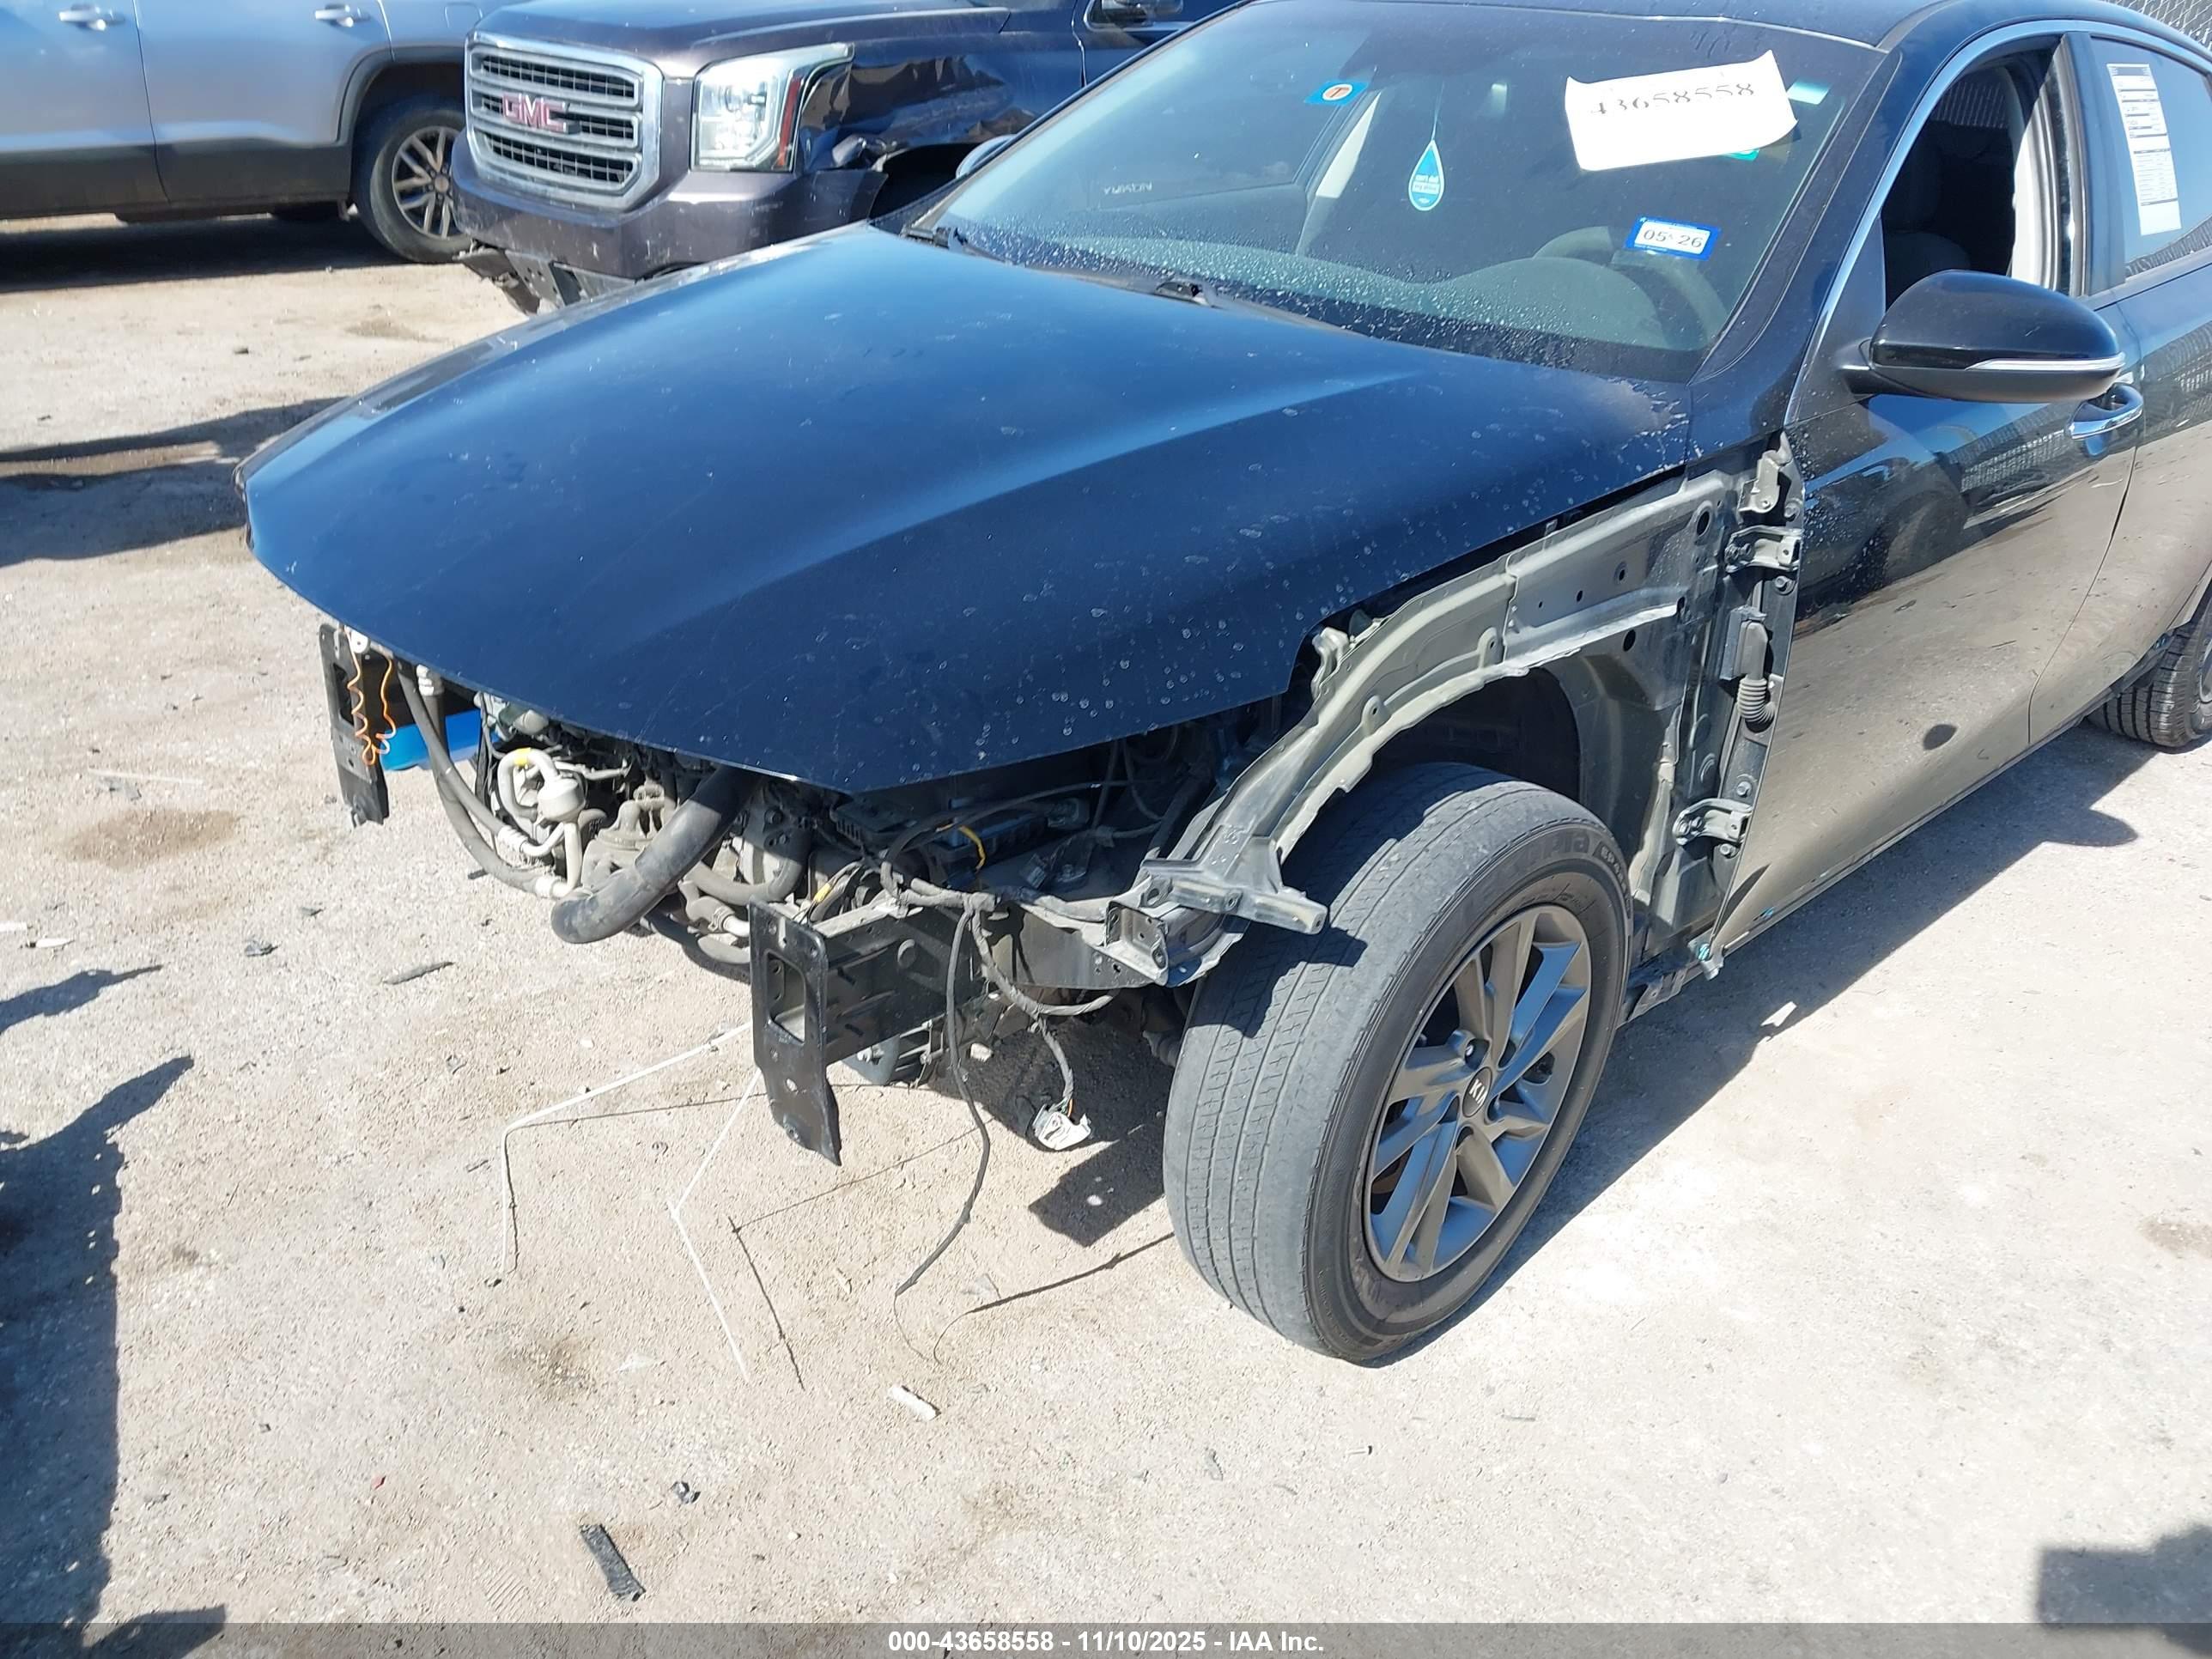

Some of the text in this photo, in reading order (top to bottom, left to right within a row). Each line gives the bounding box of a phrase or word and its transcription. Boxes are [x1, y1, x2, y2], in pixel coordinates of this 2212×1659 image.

[502, 92, 567, 135] GMC
[1643, 228, 1667, 242] 05
[1677, 234, 1704, 248] 26
[1468, 1078, 1487, 1105] KIA
